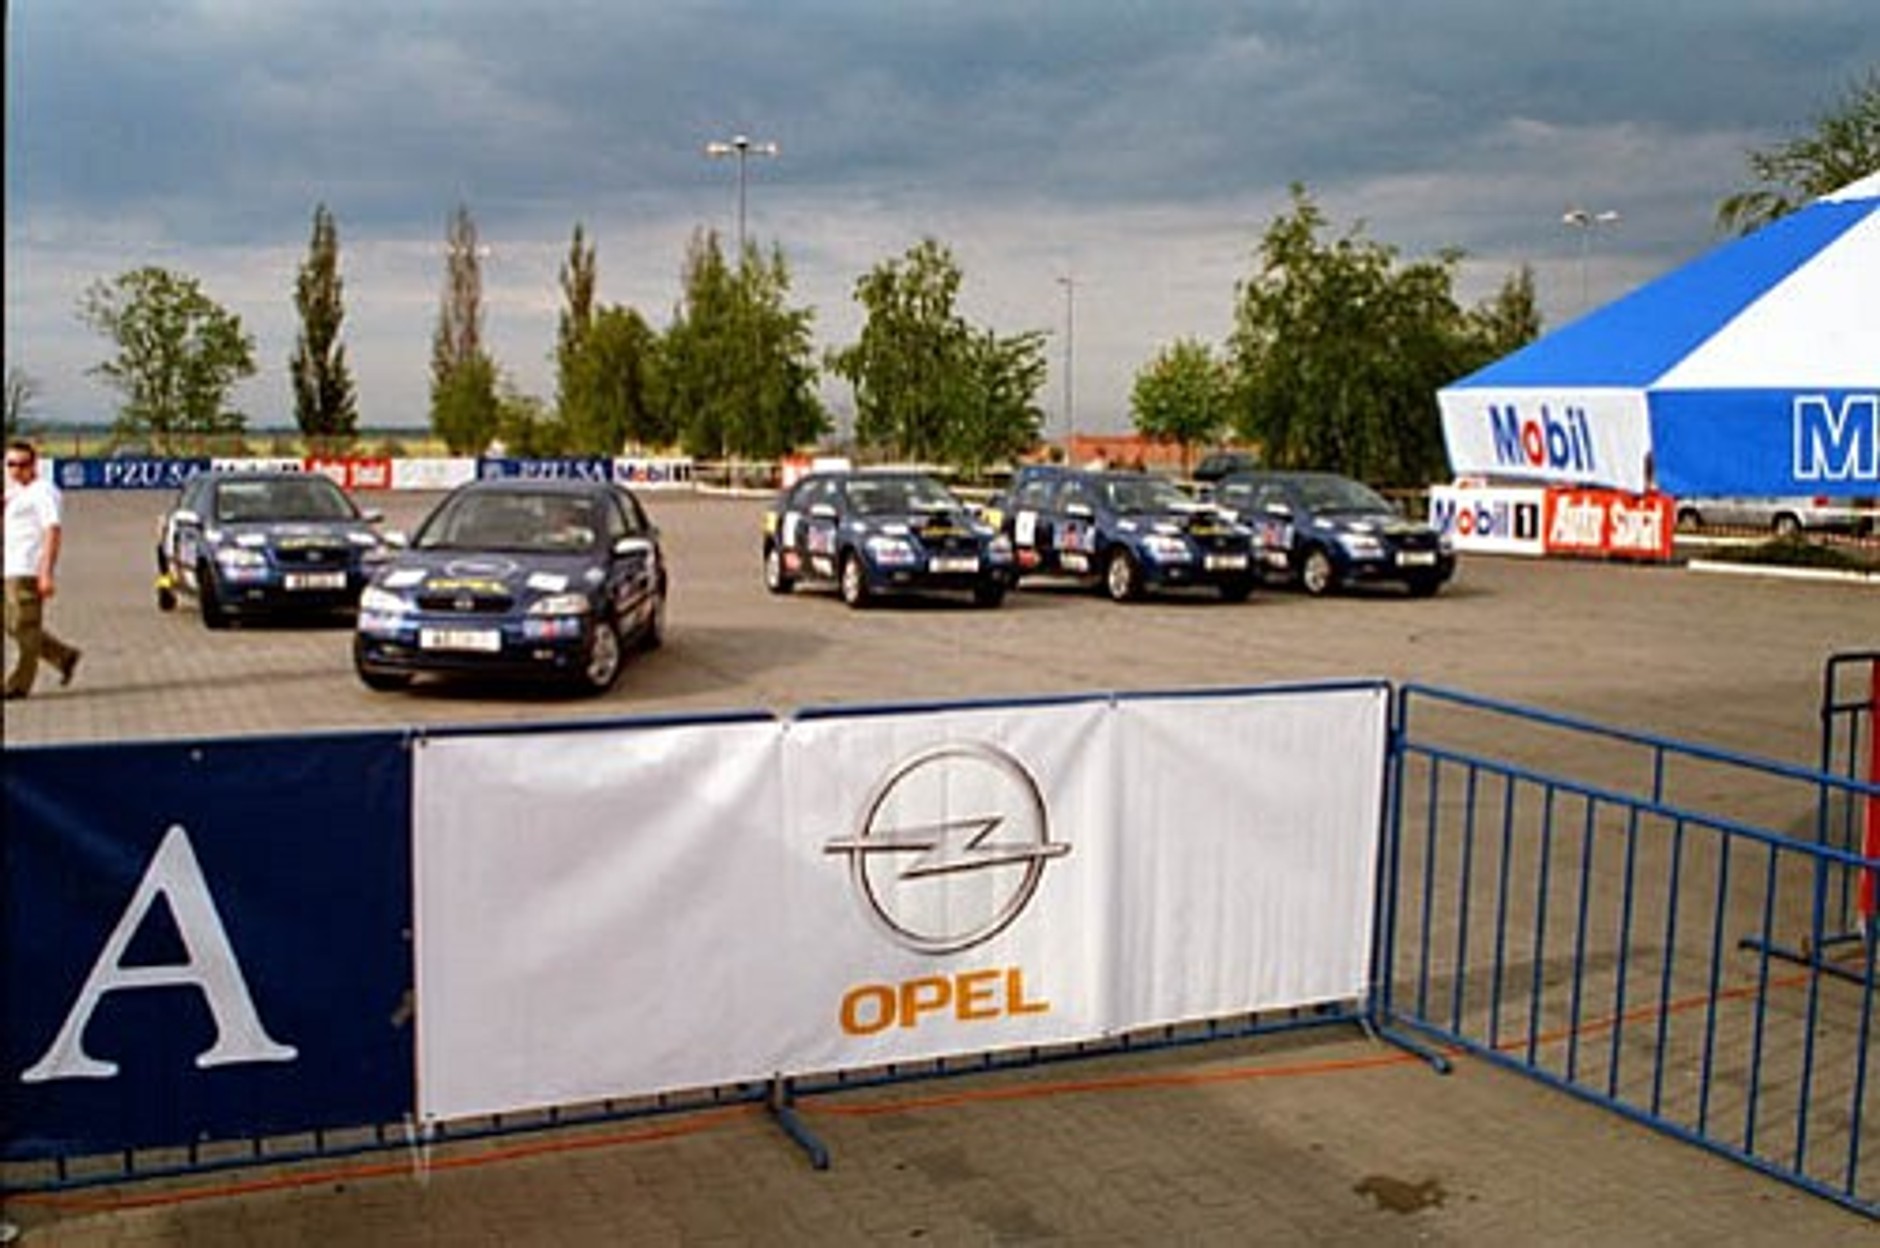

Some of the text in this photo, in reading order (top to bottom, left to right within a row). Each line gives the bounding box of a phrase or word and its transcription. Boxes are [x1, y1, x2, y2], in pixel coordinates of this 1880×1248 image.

[1488, 402, 1595, 473] Mobil
[1793, 394, 1877, 480] M
[104, 461, 162, 486] PZU
[617, 461, 671, 483] Mobil
[1434, 499, 1509, 538] Mobil
[1549, 494, 1604, 545] Auto
[20, 824, 298, 1083] A
[839, 967, 1050, 1036] OPEL
